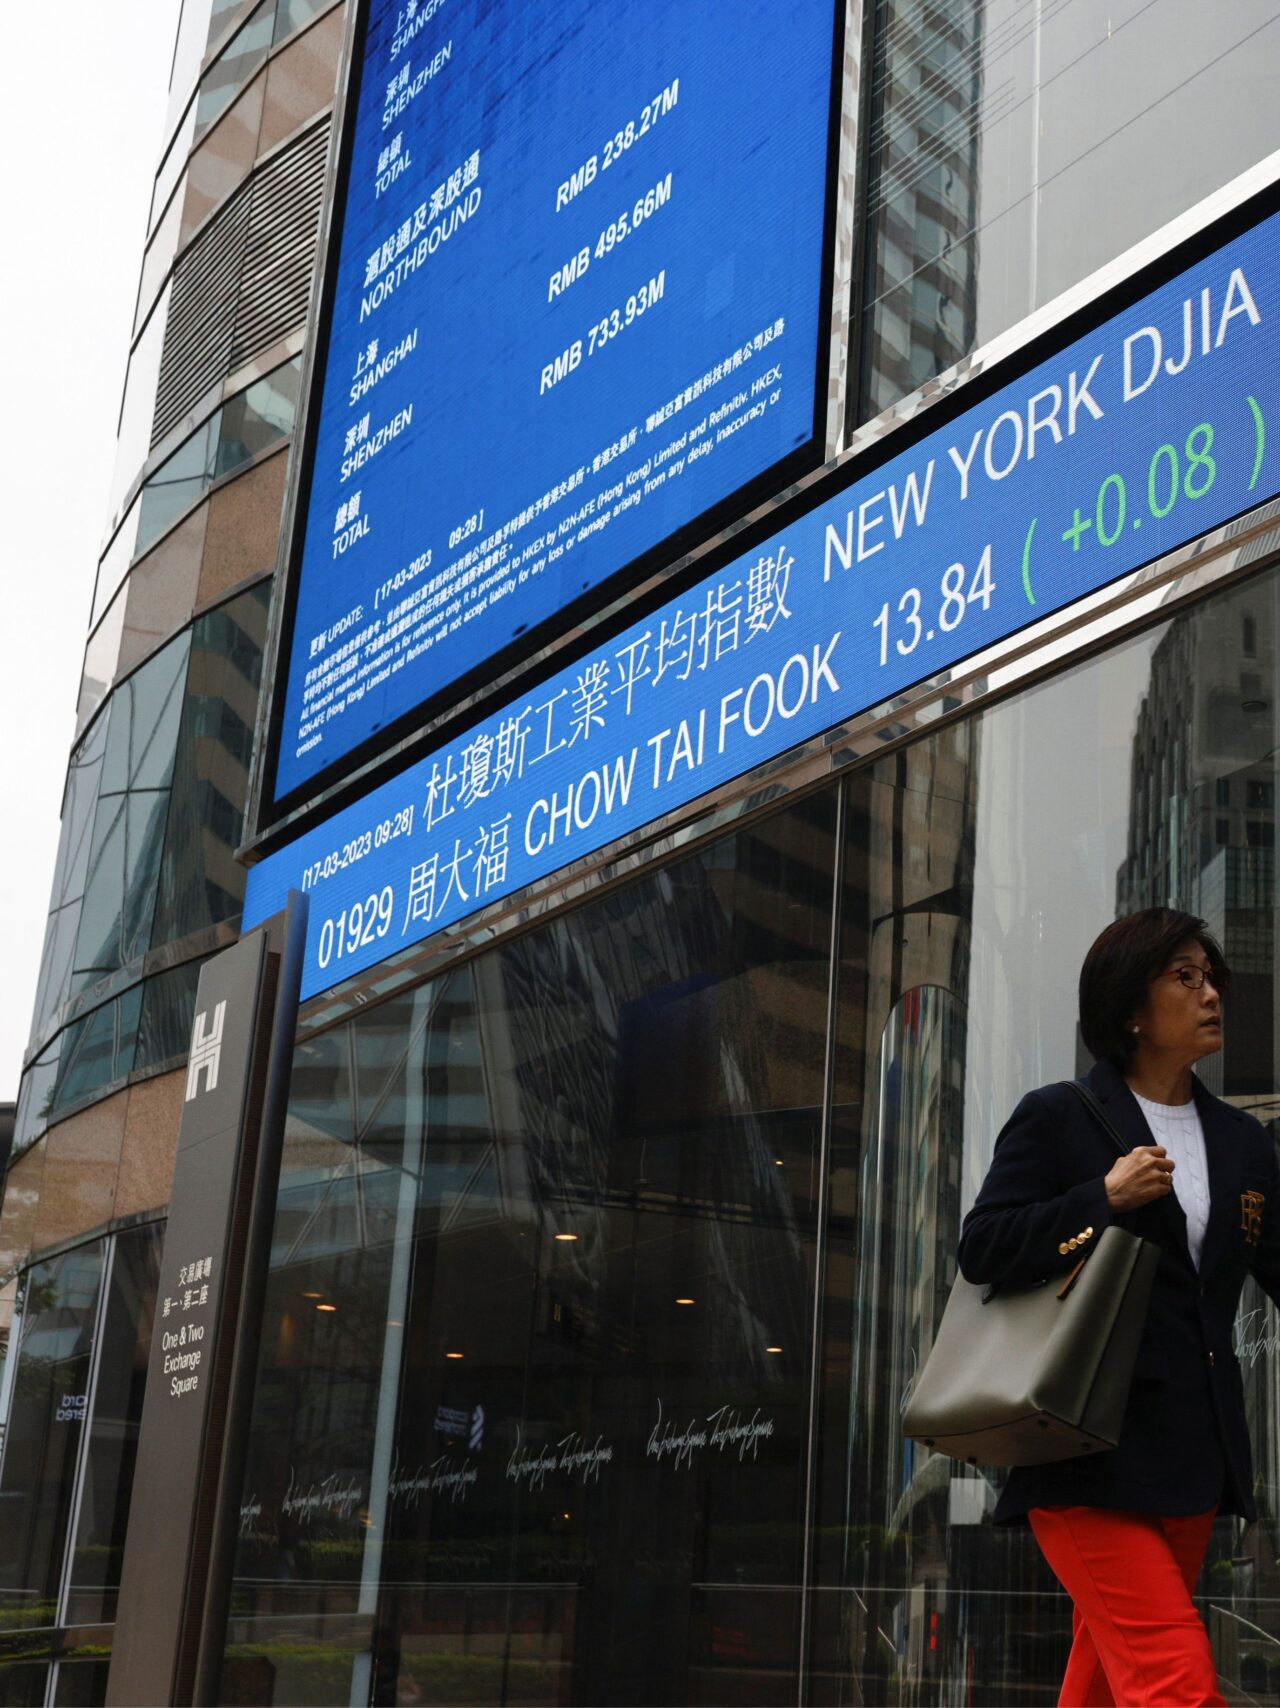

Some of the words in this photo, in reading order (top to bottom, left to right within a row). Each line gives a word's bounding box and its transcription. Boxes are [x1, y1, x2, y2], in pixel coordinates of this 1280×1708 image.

[382, 39, 452, 131] SHENZHEN
[385, 61, 410, 107] 深圳
[374, 149, 411, 199] TOTAL
[556, 154, 598, 213] RMB
[601, 77, 680, 171] 238.27M
[359, 187, 482, 323] NORTHBOUND
[363, 148, 480, 288] 滬股通及深股通
[547, 246, 590, 303] RMB
[594, 172, 672, 260] 495.66M
[349, 327, 418, 407] SHANGHAI
[352, 337, 379, 380] 上海
[540, 340, 582, 396] RMB
[588, 269, 666, 356] 733.93M
[340, 403, 413, 483] SHENZHEN
[343, 411, 370, 456] 深圳
[309, 688, 334, 714] financial
[334, 672, 356, 696] market
[356, 647, 393, 680] information
[400, 633, 412, 648] for
[411, 610, 445, 640] reference
[477, 559, 510, 597] provided
[511, 555, 521, 569] to
[521, 535, 545, 562] HKEX
[545, 529, 557, 545] by
[557, 498, 595, 536] N2N-AFE
[596, 481, 623, 510] (Hong
[625, 457, 652, 487] Kong)
[653, 431, 687, 468] Limited
[688, 417, 707, 442] and
[325, 699, 345, 721] (Hong
[345, 681, 365, 705] Kong)
[365, 663, 391, 691] Limited
[391, 653, 405, 673] and
[405, 636, 434, 662] Refinitiv
[434, 623, 448, 642] will
[449, 614, 462, 632] not
[462, 596, 487, 622] accept
[488, 577, 516, 604] liability
[517, 568, 530, 584] for
[530, 557, 546, 575] any
[547, 543, 564, 563] loss
[565, 535, 576, 550] or
[576, 510, 611, 542] damage
[612, 488, 641, 517] arising
[643, 471, 666, 495] from
[667, 457, 685, 478] any
[686, 437, 714, 464] delay,
[715, 398, 767, 443] inaccuracy
[769, 387, 781, 405] or
[332, 514, 370, 560] TOTAL
[302, 830, 372, 892] [17-03-2023
[374, 804, 414, 849] 09:28]
[422, 544, 796, 833] 杜瓊斯工業平均指數
[823, 459, 936, 583] NEW
[946, 353, 1105, 502] YORK
[1121, 267, 1262, 403] DJIA
[328, 604, 364, 643] UPDATE:
[318, 885, 394, 969] 01929
[402, 812, 513, 937] 周大福
[524, 746, 638, 856] CHOW
[647, 708, 706, 789] TAI
[718, 631, 842, 754] FOOK
[873, 544, 997, 667] 13.84
[162, 1331, 178, 1351] One
[179, 1326, 187, 1346] &
[187, 1324, 204, 1344] Two
[163, 1351, 201, 1375] Exchange
[170, 1375, 198, 1398] Square
